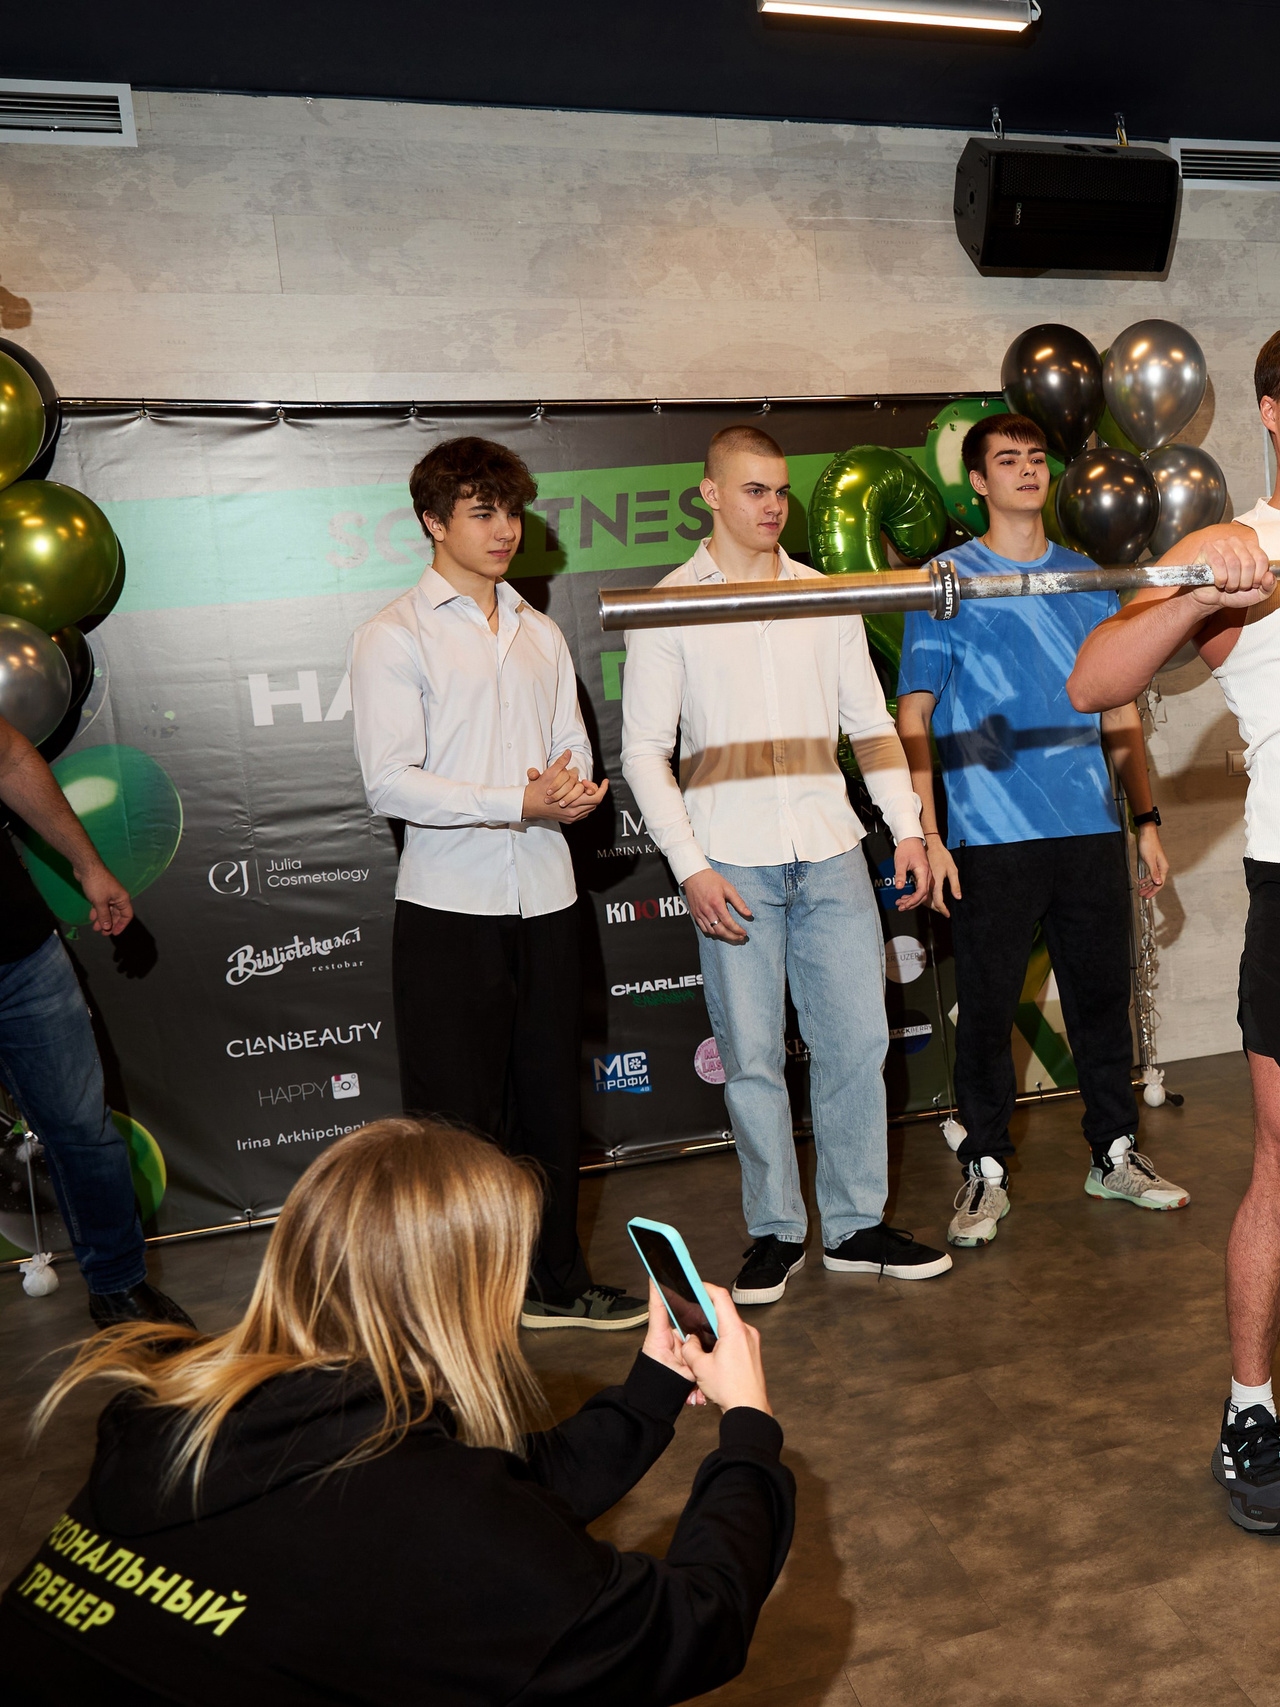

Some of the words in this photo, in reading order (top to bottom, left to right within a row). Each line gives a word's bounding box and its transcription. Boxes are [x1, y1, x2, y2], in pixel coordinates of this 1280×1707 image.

[596, 845, 643, 859] MARINA
[645, 843, 661, 854] KA
[266, 858, 303, 873] Julia
[267, 868, 371, 888] Cosmetology
[605, 895, 690, 925] КЛЮКВ
[311, 960, 365, 973] restobar
[226, 1021, 382, 1058] CLANBEAUTY
[596, 1075, 649, 1092] ПРОФИ
[258, 1081, 328, 1107] HAPPY
[333, 1080, 360, 1093] BOX
[236, 1138, 272, 1151] Irina
[16, 1562, 116, 1633] ТРЕНЕР
